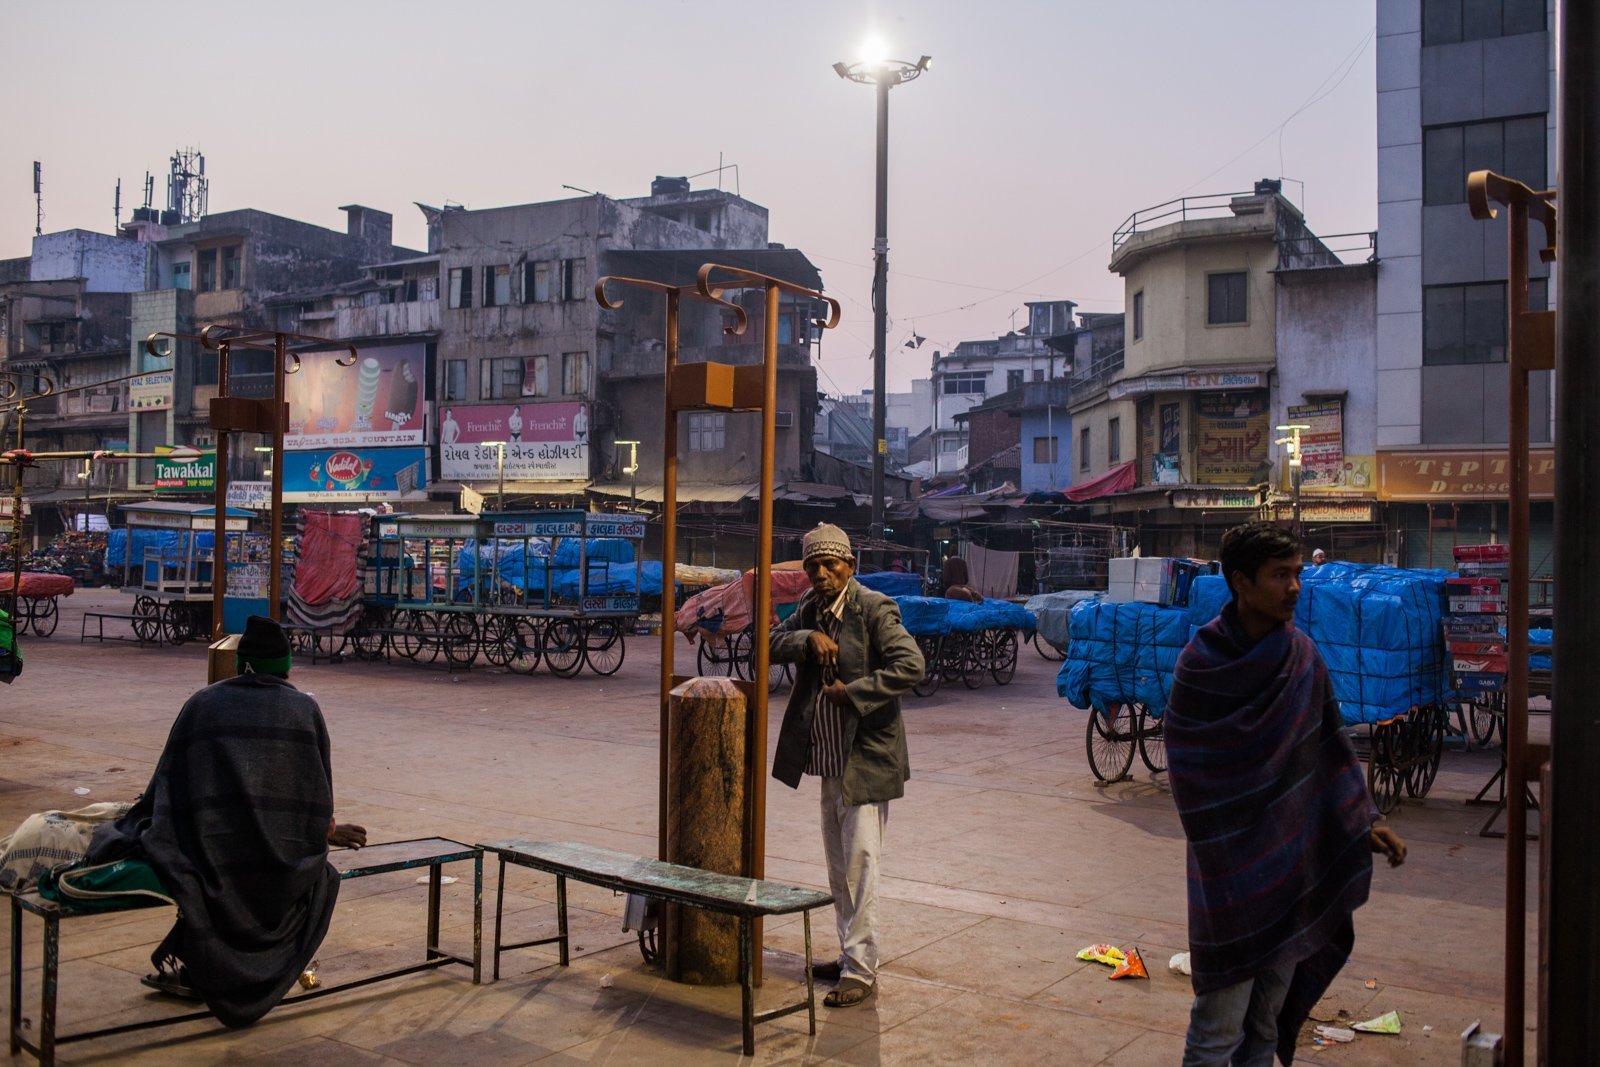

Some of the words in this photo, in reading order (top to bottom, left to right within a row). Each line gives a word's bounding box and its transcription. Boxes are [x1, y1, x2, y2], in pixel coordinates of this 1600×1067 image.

[131, 378, 143, 386] AYAZ
[146, 375, 172, 385] SELECTION
[467, 419, 502, 432] Frenchie
[530, 417, 567, 431] Frenchie
[362, 434, 416, 443] FOUNTAIN
[156, 462, 214, 479] Tawakkal
[328, 456, 359, 476] Vadilal
[1491, 458, 1555, 475] TP
[244, 661, 256, 674] A
